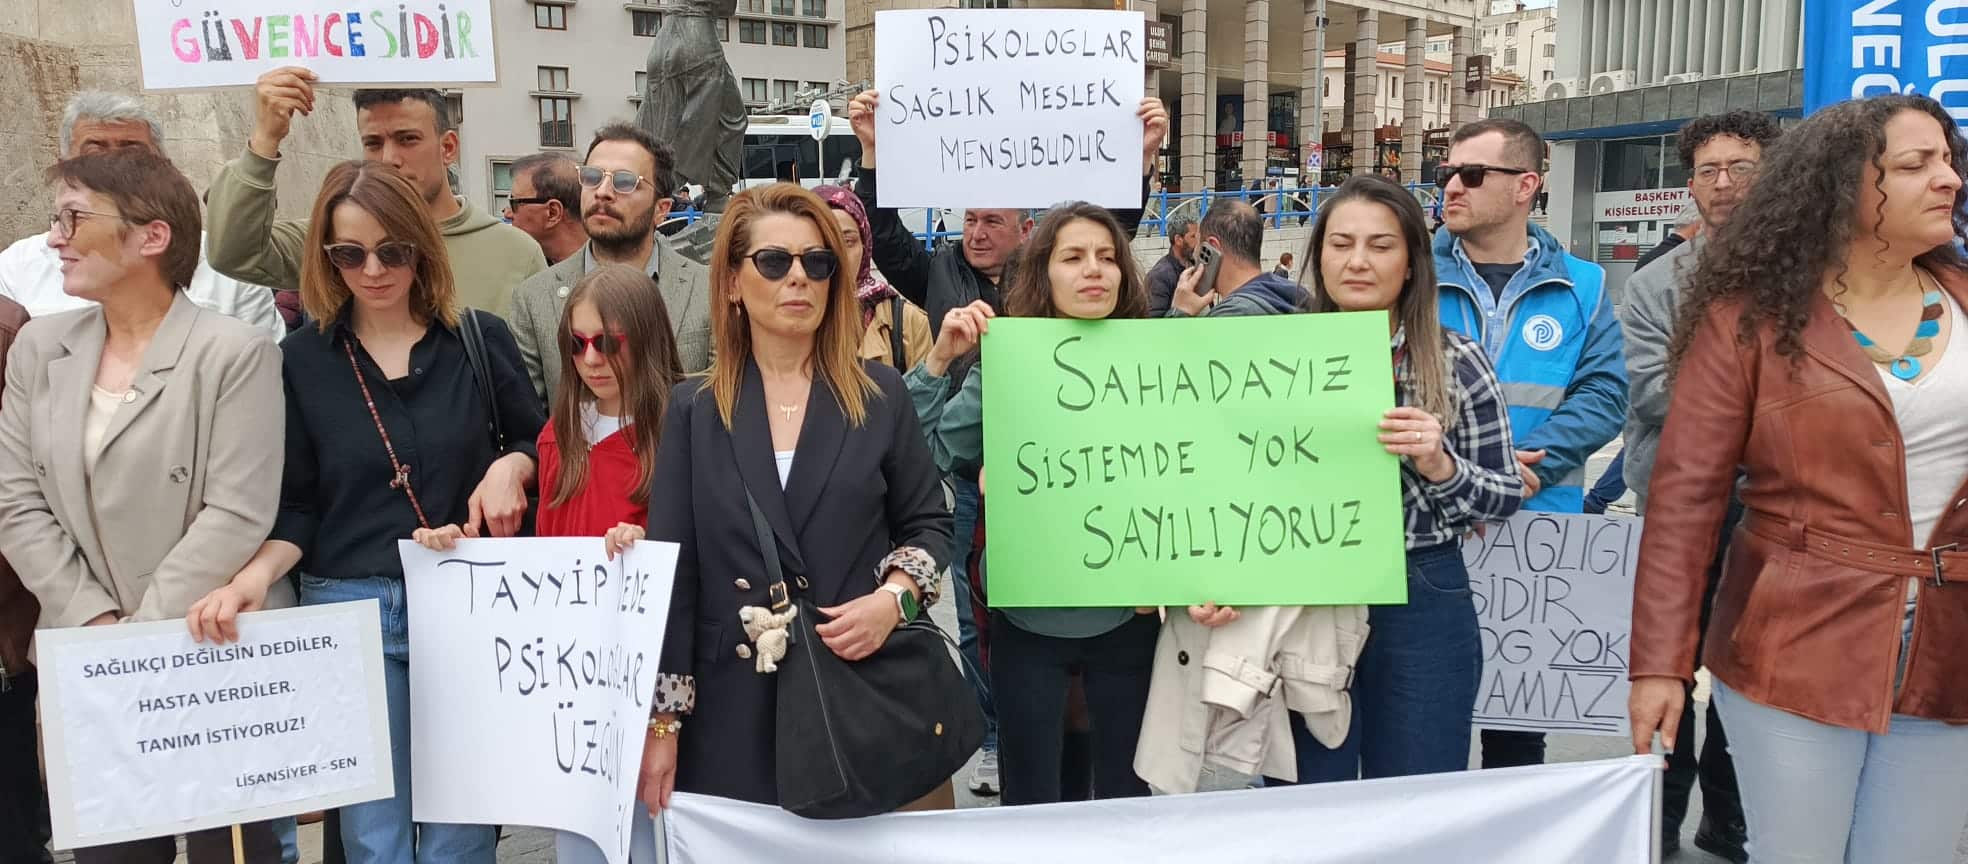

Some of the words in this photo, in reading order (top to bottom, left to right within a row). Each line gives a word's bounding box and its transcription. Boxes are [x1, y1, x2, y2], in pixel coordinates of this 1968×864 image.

[170, 3, 480, 63] GÜVENCESİDİR
[928, 16, 1138, 70] PSİKOLOGLAR
[889, 84, 995, 125] SAĞLIK
[1019, 78, 1121, 112] MESLEK
[940, 130, 1117, 173] MENSUBUDUR
[1635, 191, 1684, 202] BAŞKENT
[1053, 336, 1353, 411] SAHADAYIZ
[1017, 441, 1195, 495] SİSTEMDE
[1238, 425, 1320, 474] YOK
[1083, 500, 1362, 570] SAYILIYORUZ
[438, 558, 608, 615] TAYYİP
[83, 658, 166, 679] SAĞLIKÇI
[172, 646, 255, 668] DEĞİLSİN
[261, 635, 339, 657] DEDİLER,
[1548, 628, 1628, 669] YOK
[138, 693, 200, 713] HASTA
[204, 681, 296, 703] VERDİLER.
[1472, 668, 1625, 720] AMAZ
[137, 734, 201, 754] TANIM
[206, 716, 306, 744] İSTİYORUZ!
[236, 764, 318, 787] LİSANSİYER
[330, 756, 358, 770] SEN
